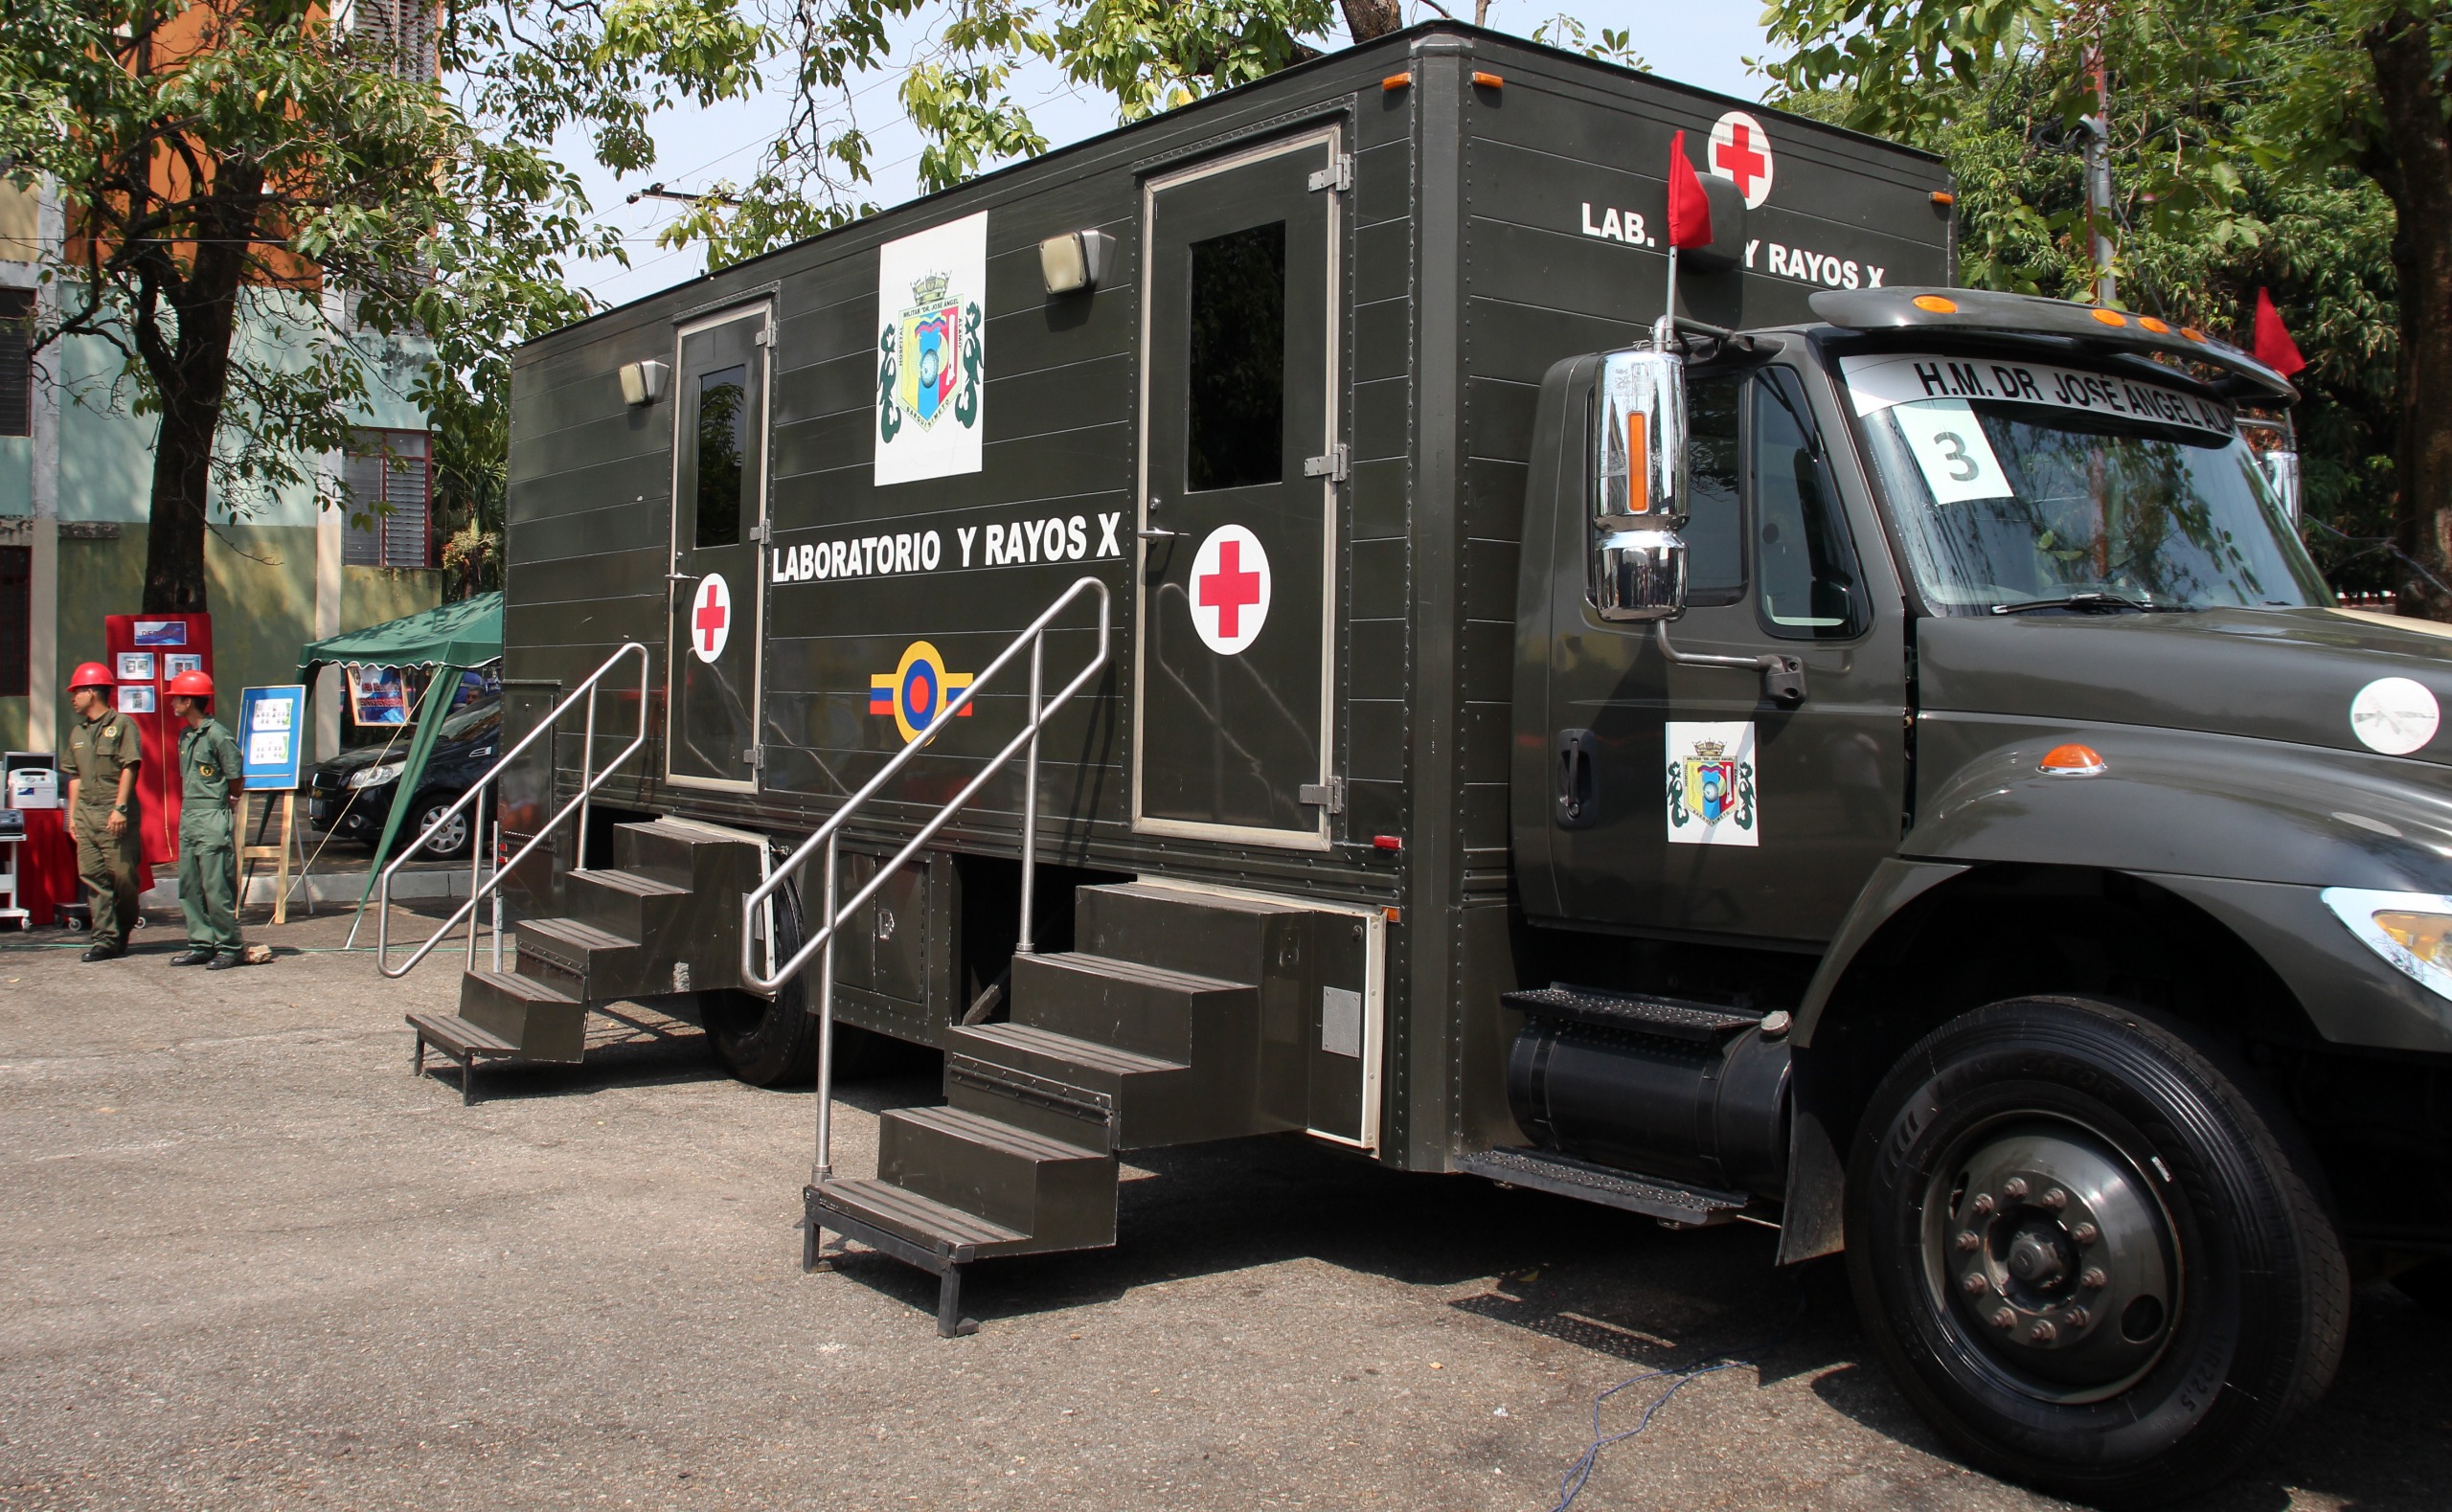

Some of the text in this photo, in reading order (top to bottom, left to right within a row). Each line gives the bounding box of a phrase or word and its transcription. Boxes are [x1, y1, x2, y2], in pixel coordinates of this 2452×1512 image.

[1582, 202, 1885, 290] LAB. Y RAYOS X
[1913, 362, 1994, 396] H.M.
[1990, 365, 2044, 400] DR
[1933, 431, 1980, 483] 3
[772, 511, 1122, 583] LABORATORIO Y RAYOS X
